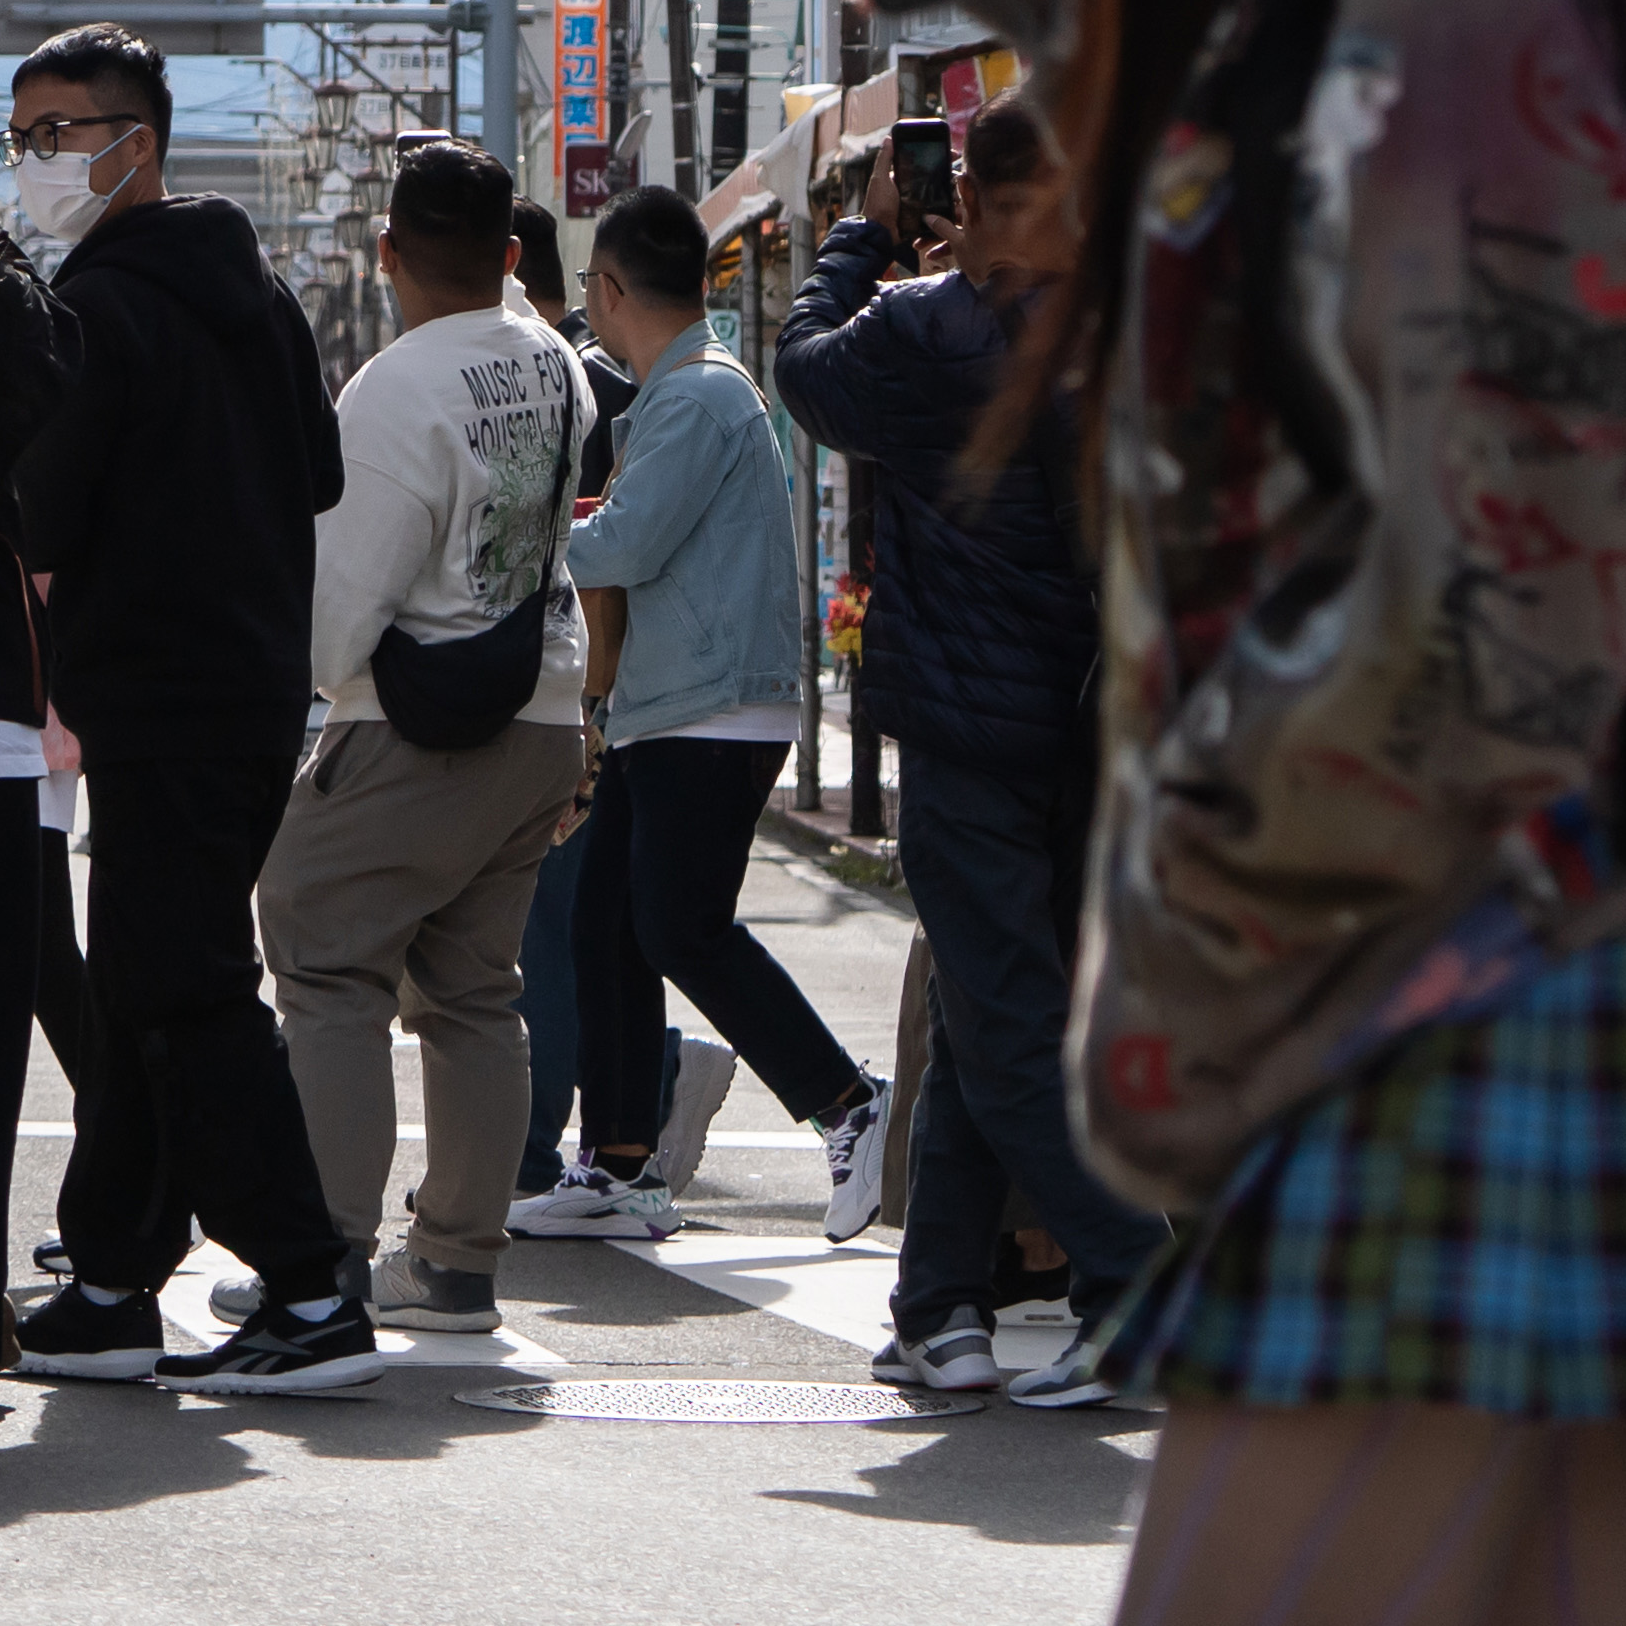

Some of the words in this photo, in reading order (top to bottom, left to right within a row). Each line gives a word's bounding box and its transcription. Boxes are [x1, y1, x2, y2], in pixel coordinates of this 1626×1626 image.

[563, 15, 598, 141] 渡辺薬
[460, 359, 527, 410] MUSIC
